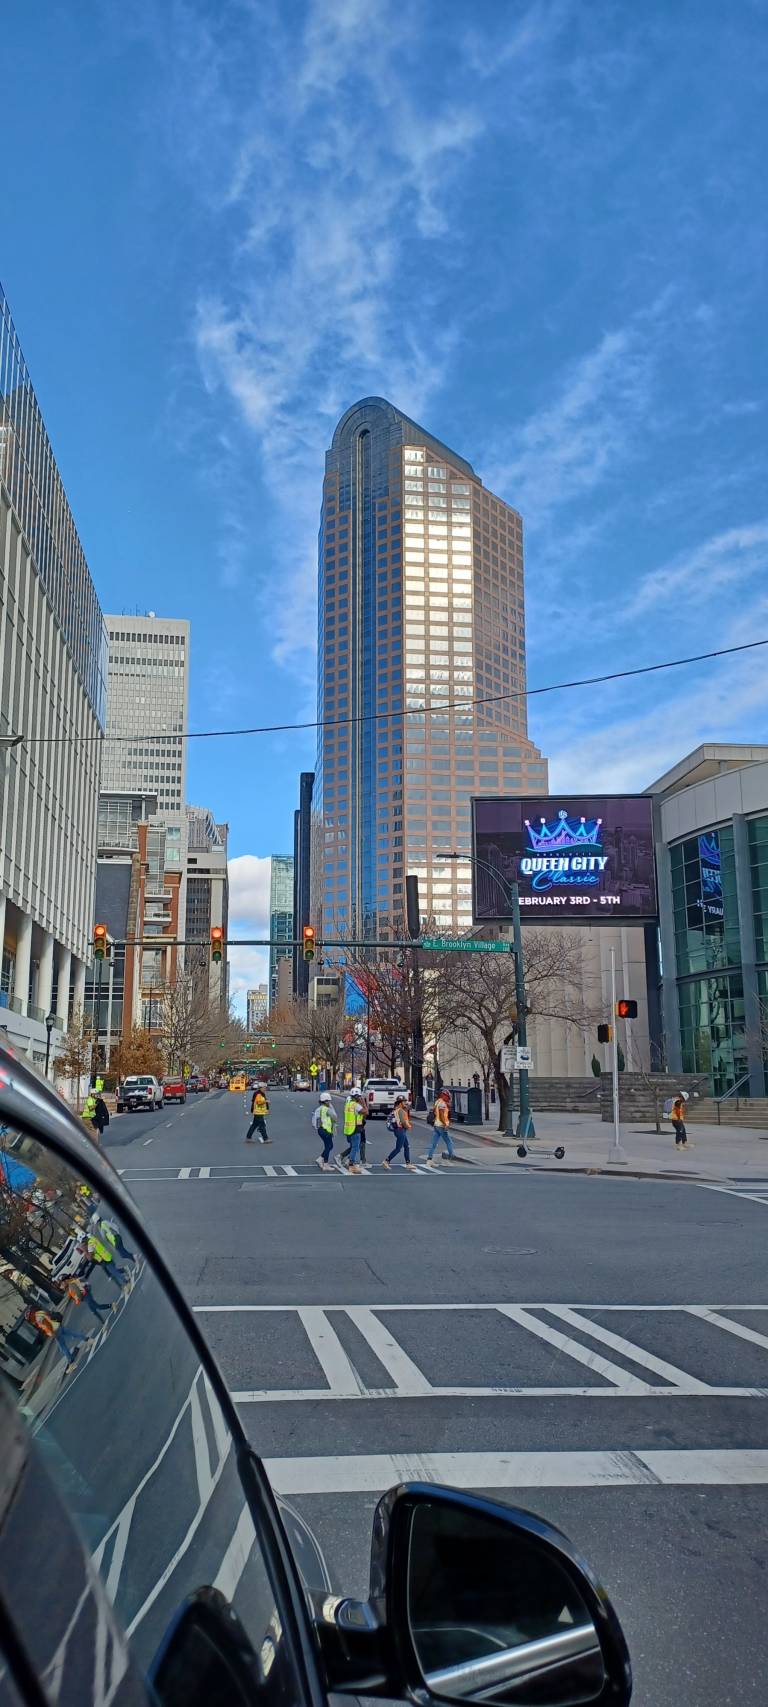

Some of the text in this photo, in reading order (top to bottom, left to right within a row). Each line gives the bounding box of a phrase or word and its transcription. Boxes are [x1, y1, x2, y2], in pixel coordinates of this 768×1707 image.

[521, 856, 608, 875] QUEEN CITY
[532, 870, 600, 891] Classic
[518, 897, 567, 905] EBRUARY
[569, 896, 591, 905] 3RD
[600, 896, 620, 905] 5TH
[441, 940, 472, 949] Brooklyn
[474, 941, 496, 951] Village
